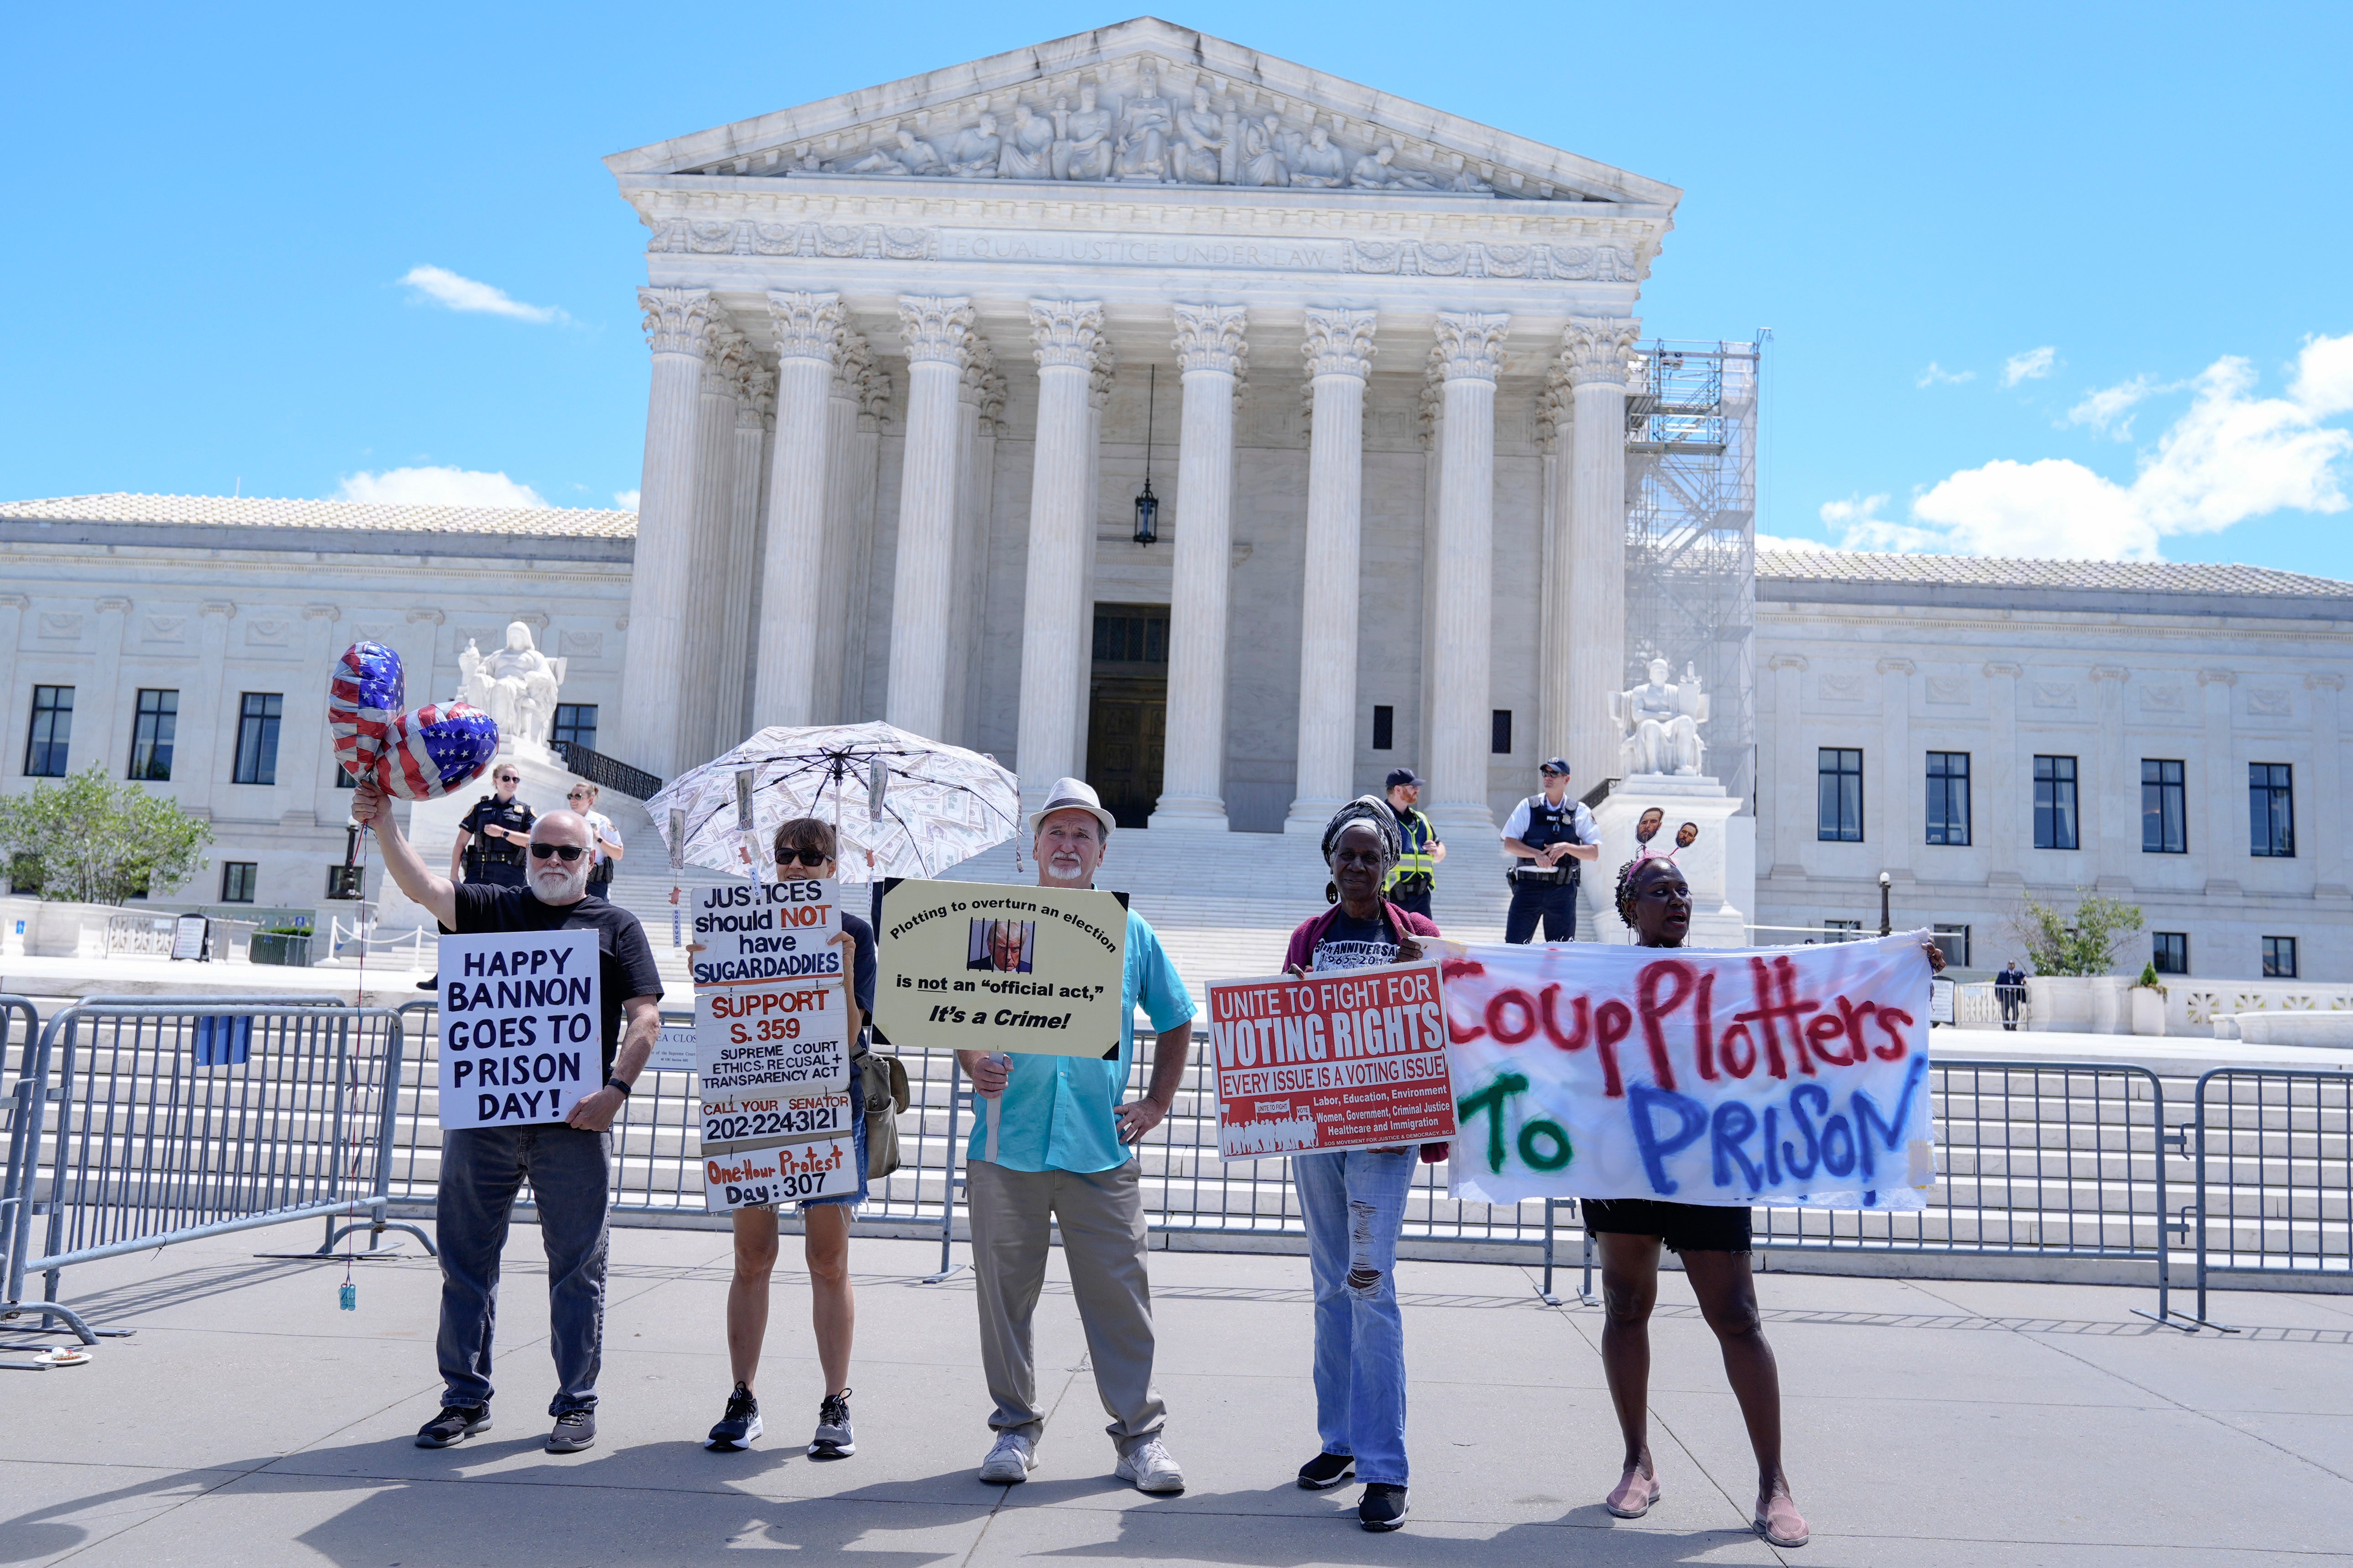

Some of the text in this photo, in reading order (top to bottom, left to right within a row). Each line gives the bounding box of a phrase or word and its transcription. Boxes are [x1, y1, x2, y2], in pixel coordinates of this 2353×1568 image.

[955, 237, 1326, 266] EQUAL JUSTICE UNDER LAW
[741, 818, 752, 829] 100
[671, 858, 682, 867] 100
[695, 904, 832, 933] should NOT
[889, 898, 1116, 953] Plotting to overturn an election
[739, 934, 797, 955] have
[1333, 942, 1398, 957] ANNIVERSA
[464, 947, 573, 977] HAPPY
[694, 951, 839, 984] SUGARDADDIES
[448, 977, 591, 1012] BANNON
[896, 974, 912, 988] is
[917, 977, 948, 990] not
[953, 979, 975, 992] an
[1218, 974, 1432, 1019] UNITE TO FIGHT FOR
[712, 989, 829, 1019] SUPPORT
[448, 1013, 591, 1051] GOES TO
[971, 1011, 987, 1024] a
[994, 1009, 1072, 1030] Crime!
[1213, 1001, 1444, 1068] VOTING RIGHTS
[713, 1053, 842, 1075] ETHICS, RECUSAL +
[721, 1040, 838, 1061] SUPREME COURT
[454, 1052, 580, 1088] PRISON
[702, 1066, 839, 1089] TRANSPARENCY ACT
[1223, 1055, 1445, 1096] EVERY ISSUE IS A VOTING ISSUE
[478, 1089, 561, 1121] DAY!
[703, 1096, 849, 1116] CALL YOUR SENATOR
[1313, 1084, 1447, 1107] Labor, Education, Environment
[706, 1108, 838, 1140] 202-224-3121
[1316, 1100, 1450, 1124] Women, Government, Criminal Justice
[1327, 1117, 1438, 1136] Healthcare and Immigration
[1626, 1055, 1925, 1196] PRISON
[707, 1144, 844, 1185] One-Hour Protest
[783, 1171, 827, 1197] 307
